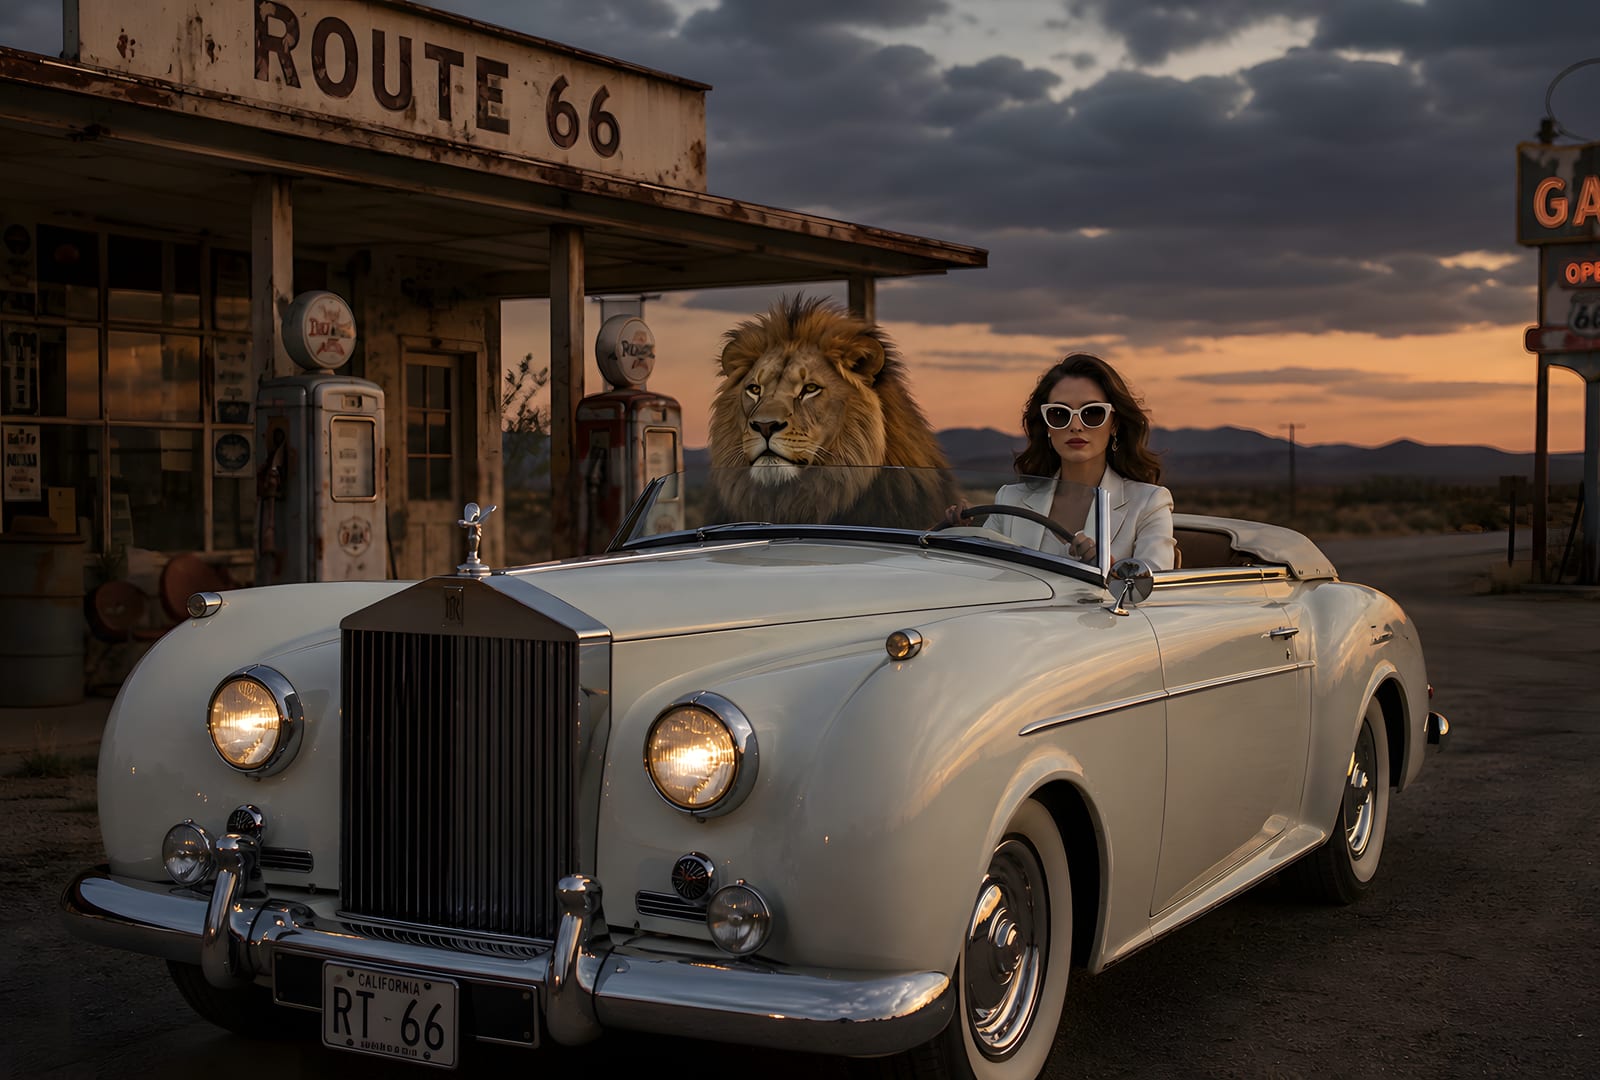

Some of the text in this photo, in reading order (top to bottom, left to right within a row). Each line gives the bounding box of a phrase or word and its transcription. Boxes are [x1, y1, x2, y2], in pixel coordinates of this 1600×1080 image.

[254, 0, 621, 158] ROUTE 66
[1533, 176, 1600, 229] GA
[358, 973, 420, 996] CALIFORNIA
[333, 985, 445, 1051] RT 66
